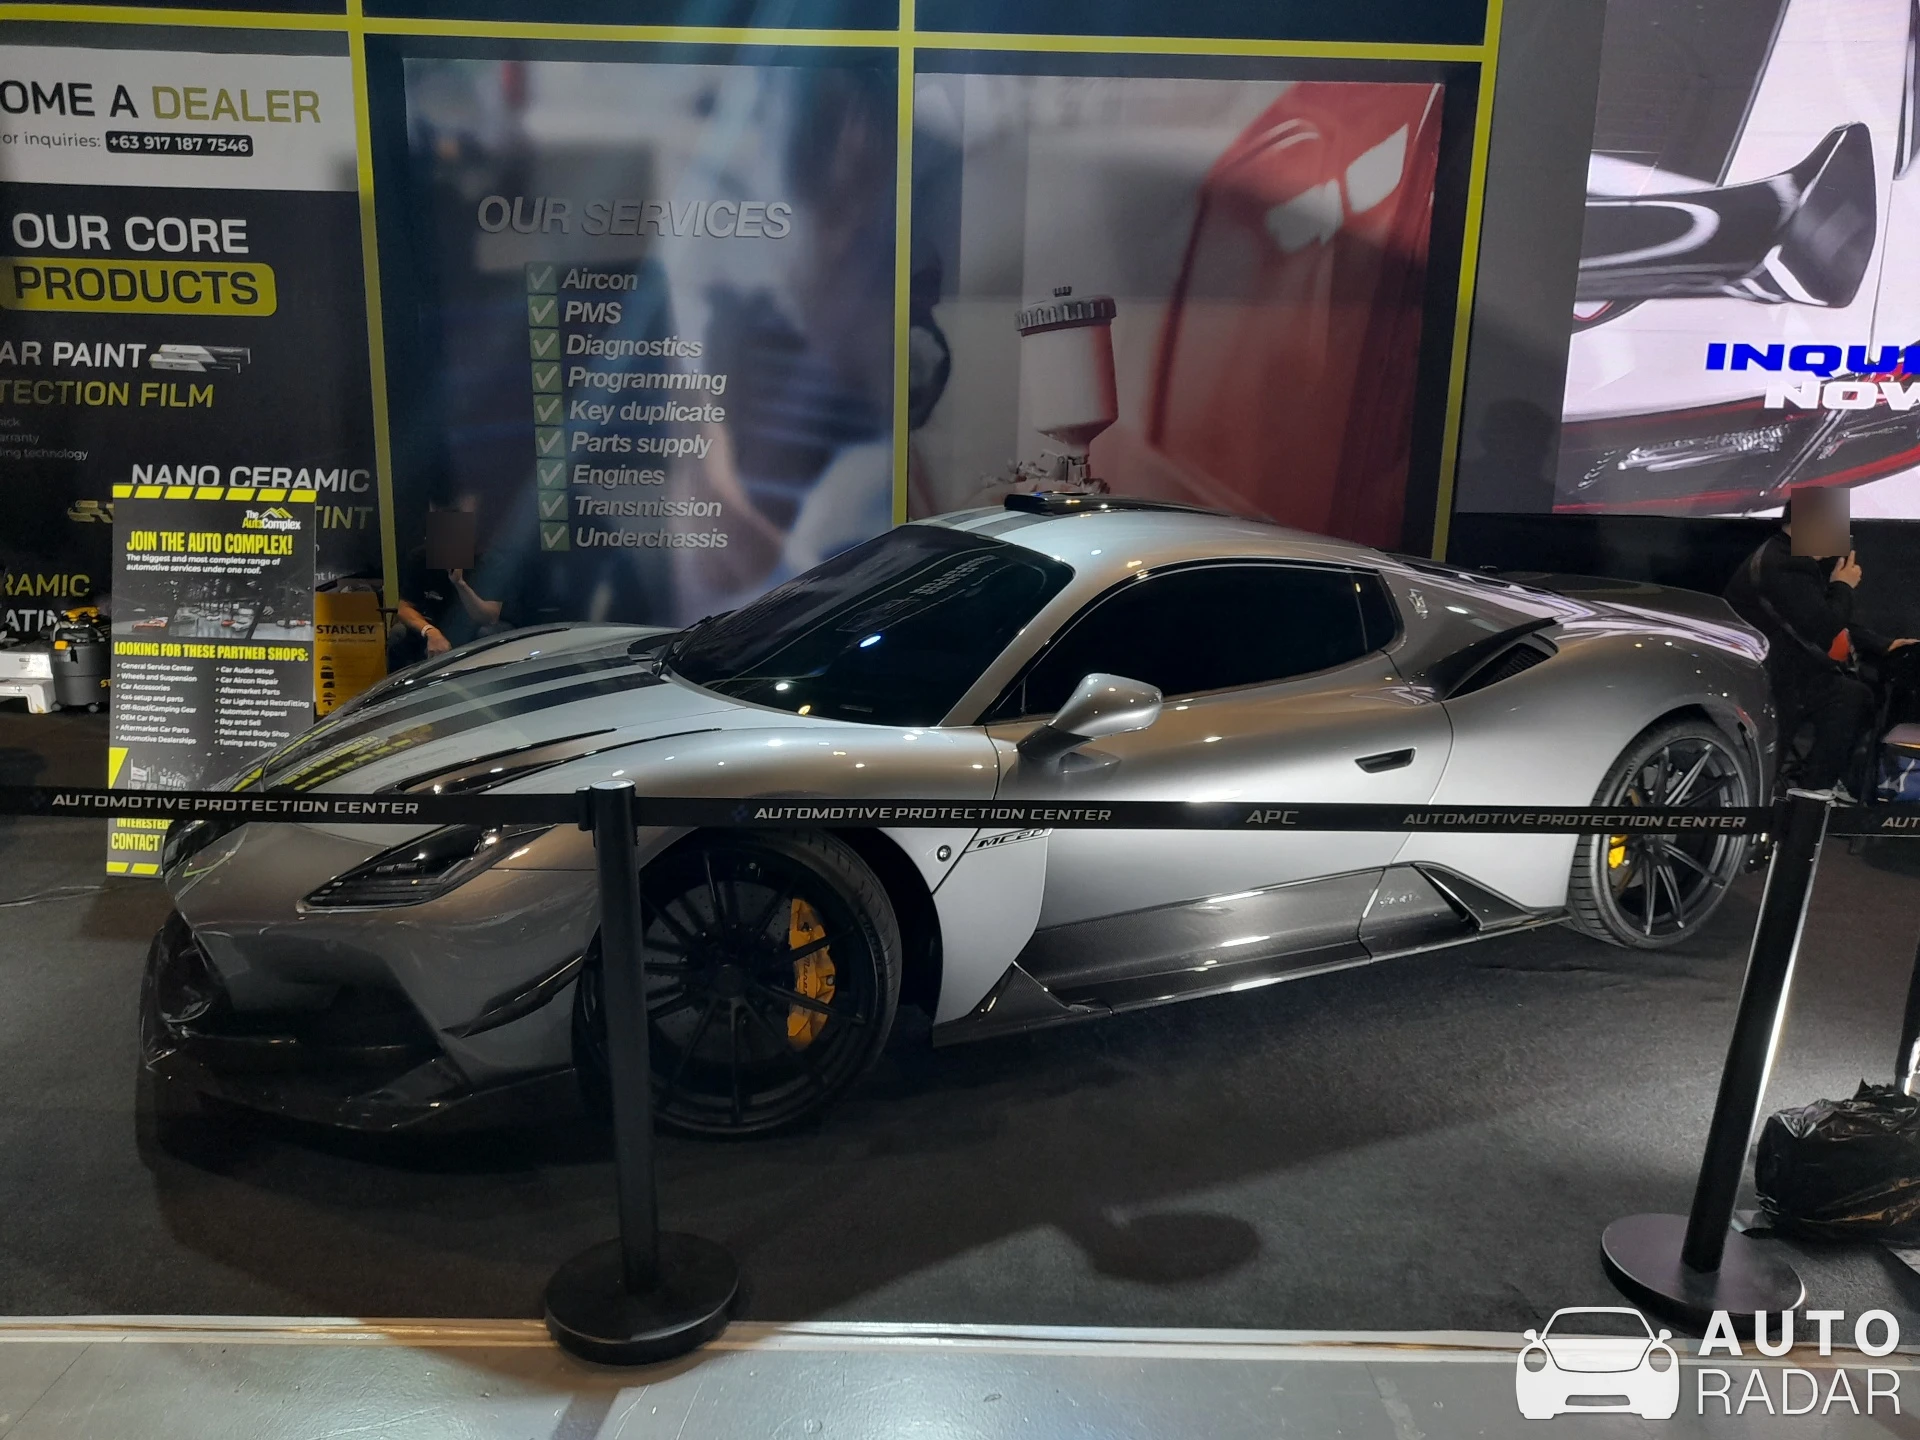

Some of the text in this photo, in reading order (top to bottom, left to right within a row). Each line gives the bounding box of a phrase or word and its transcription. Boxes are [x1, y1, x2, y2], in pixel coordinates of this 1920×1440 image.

[110, 84, 139, 119] A
[152, 86, 321, 123] DEALER
[24, 132, 101, 149] inquiries:
[109, 137, 140, 150] +63
[144, 137, 170, 150] 917
[175, 138, 203, 151] 187
[207, 139, 249, 153] 7546
[477, 195, 793, 239] OUR SERVICES
[12, 213, 249, 253] OUR CORE
[13, 266, 259, 305] PRODUCTS
[562, 268, 639, 291] Aircon
[564, 301, 622, 325] PMS
[566, 334, 703, 361] Diagnostics
[53, 342, 148, 369] PAINT
[568, 366, 728, 395] Programming
[139, 383, 215, 408] FILM
[569, 400, 726, 426] Key duplicate
[570, 431, 713, 459] Parts supply
[24, 448, 89, 462] technology
[131, 463, 371, 492] NANO CERAMIC
[572, 464, 666, 490] Engines
[246, 509, 259, 519] The
[574, 495, 723, 518] Transmission
[242, 517, 301, 532] AutoComplex
[126, 531, 157, 551] JOIN
[159, 532, 185, 552] THE
[188, 533, 222, 554] AUTO
[224, 534, 293, 555] COMPLEX!
[576, 526, 729, 549] Underchassis
[126, 553, 281, 567] The biggest and most complete range of
[126, 563, 169, 572] automotive
[170, 564, 201, 573] services
[202, 565, 226, 574] under
[243, 566, 262, 575] roof.
[316, 624, 375, 635] STANLEY
[114, 641, 309, 662] LOOKING FOR THESE PARTNER SHOPS:
[121, 662, 194, 672] General Service Center
[233, 666, 254, 674] Audio
[254, 667, 275, 676] setup
[121, 672, 197, 682] Wheels and Suspension
[256, 678, 279, 686] Repair
[120, 682, 171, 691] Car Accessories
[220, 687, 261, 695] Aftermarket
[133, 694, 152, 702] setup
[233, 698, 254, 706] Lights
[269, 699, 309, 708] Retrofitting
[181, 706, 197, 714] Gear
[220, 708, 287, 718] Automotive Apparel
[136, 714, 148, 722] Car
[149, 715, 166, 723] Parts
[220, 718, 234, 726] Buy
[234, 718, 248, 726] and
[120, 724, 190, 734] Aftermarket Car Parts
[220, 728, 238, 736] Paint
[253, 730, 271, 738] Body
[271, 730, 290, 738] Shop
[120, 734, 197, 745] Automotive Dealerships
[219, 738, 243, 747] Tuning
[258, 740, 277, 748] Dyno
[52, 793, 419, 815] AUTOMOTIVE PROTECTION CENTER
[754, 806, 1112, 822] AUTOMOTIVE PROTECTION CENTER
[1246, 810, 1299, 825] APC
[1402, 813, 1747, 829] AUTOMOTIVE PROTECTION CENTER
[111, 832, 161, 852] CONTACT
